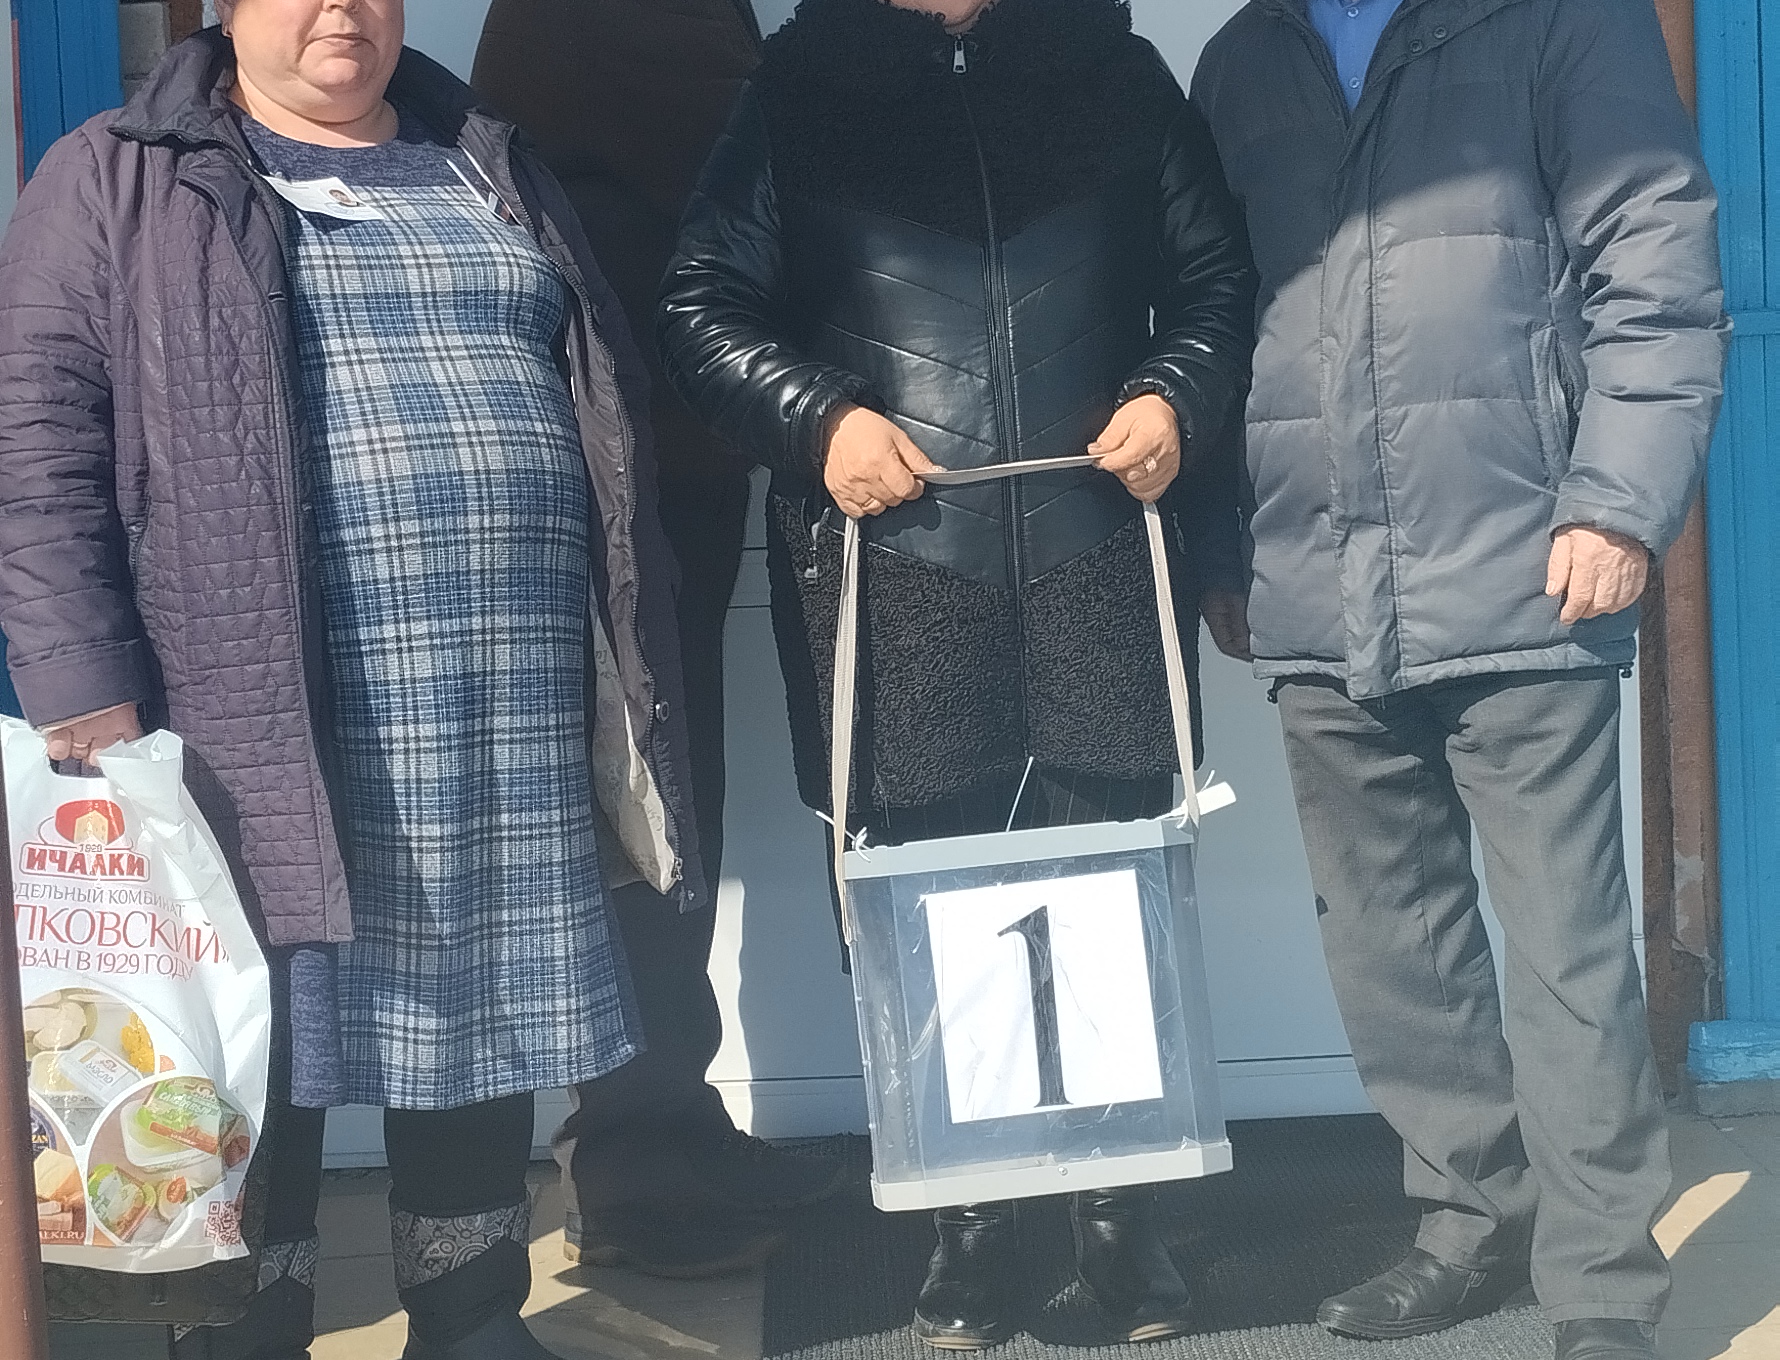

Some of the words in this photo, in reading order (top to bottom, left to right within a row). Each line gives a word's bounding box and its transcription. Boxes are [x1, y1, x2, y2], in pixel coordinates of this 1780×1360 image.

[26, 847, 146, 878] ИЧАЛКИ
[108, 889, 186, 919] КОМБИНАТ
[18, 946, 71, 968] ВАН
[77, 950, 92, 971] В
[97, 952, 140, 975] 1929
[144, 953, 194, 983] ГОДУ
[998, 905, 1074, 1108] 1
